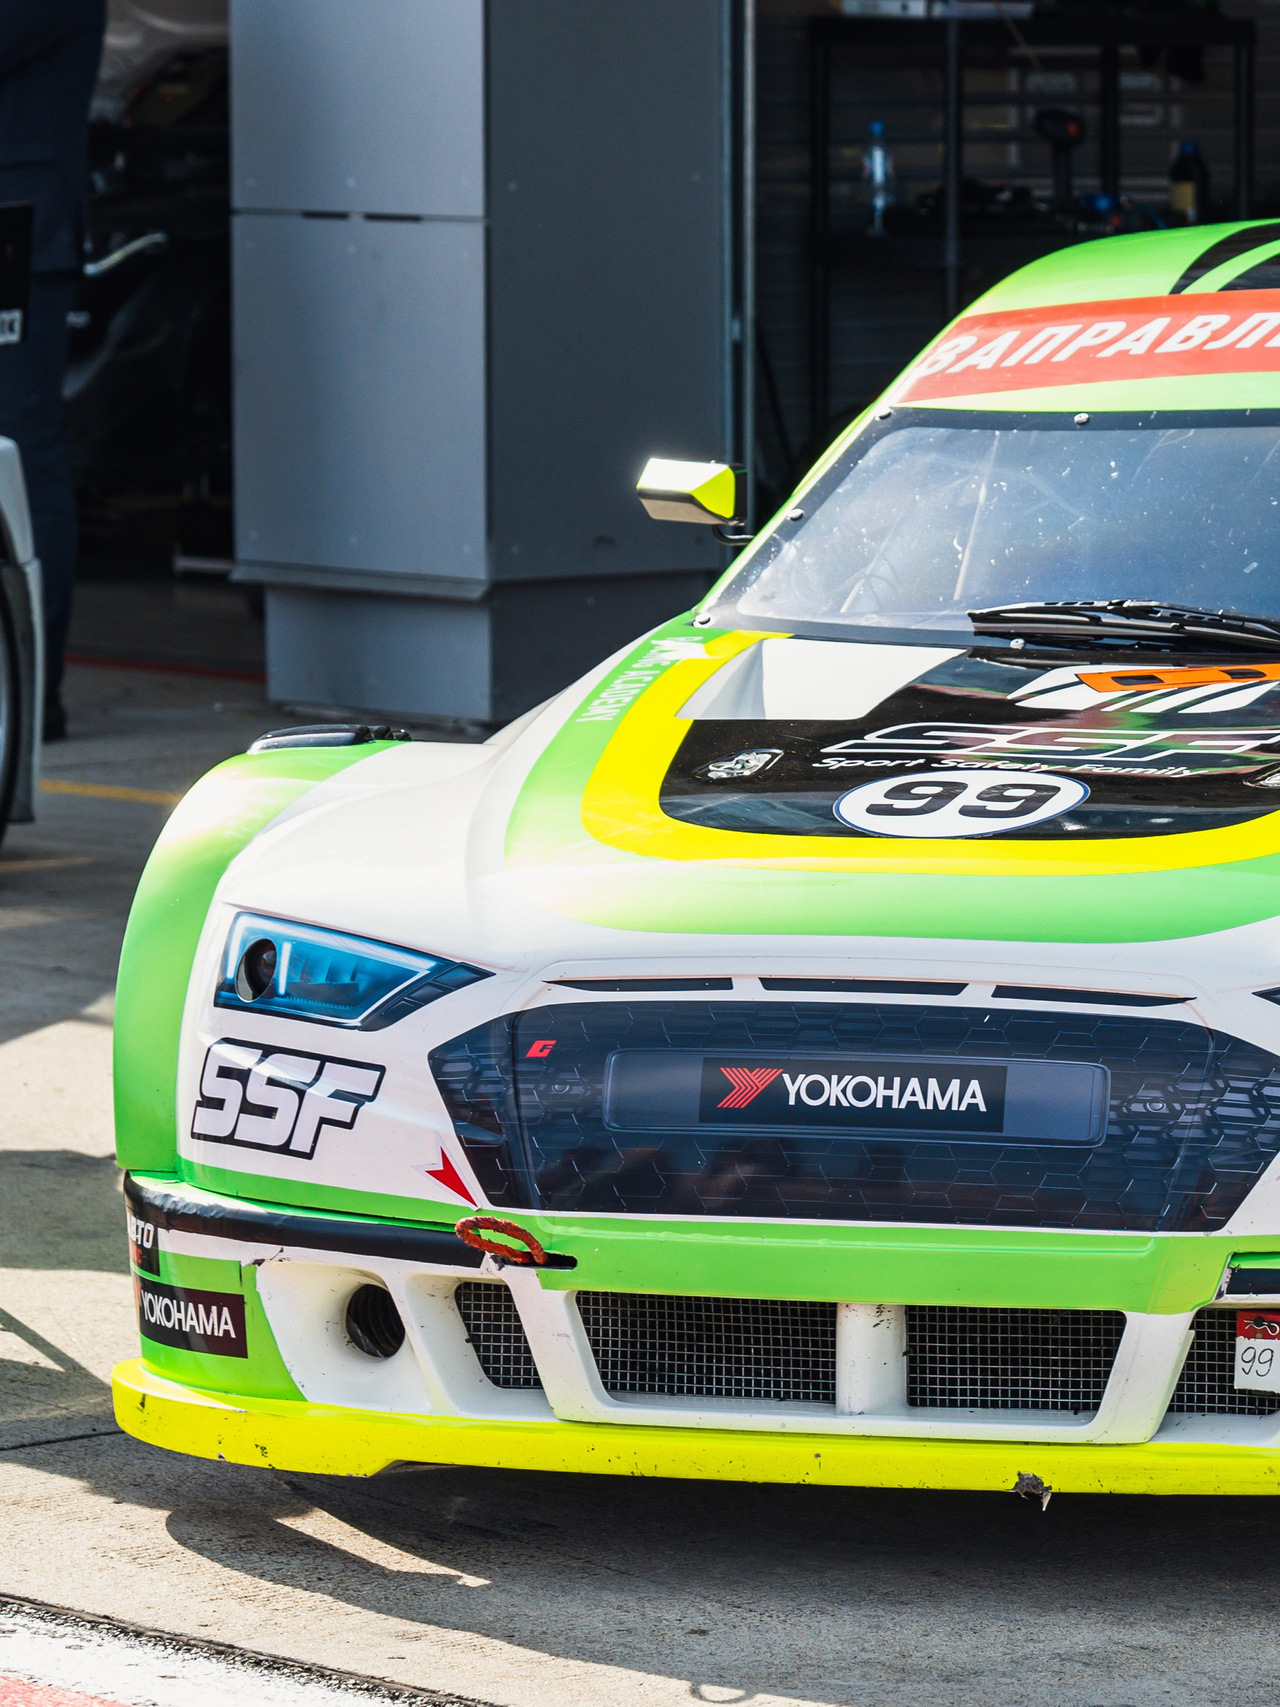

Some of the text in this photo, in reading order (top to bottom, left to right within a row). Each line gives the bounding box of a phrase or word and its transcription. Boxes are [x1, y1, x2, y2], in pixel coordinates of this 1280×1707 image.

[575, 669, 661, 722] ACADEMY
[812, 757, 1208, 778] Sport Safety Family
[866, 780, 1061, 818] 99
[191, 1038, 386, 1160] SSF
[782, 1073, 987, 1112] YOKOHAMA
[141, 1289, 236, 1338] YOKOHAMA
[1241, 1346, 1274, 1377] 99
